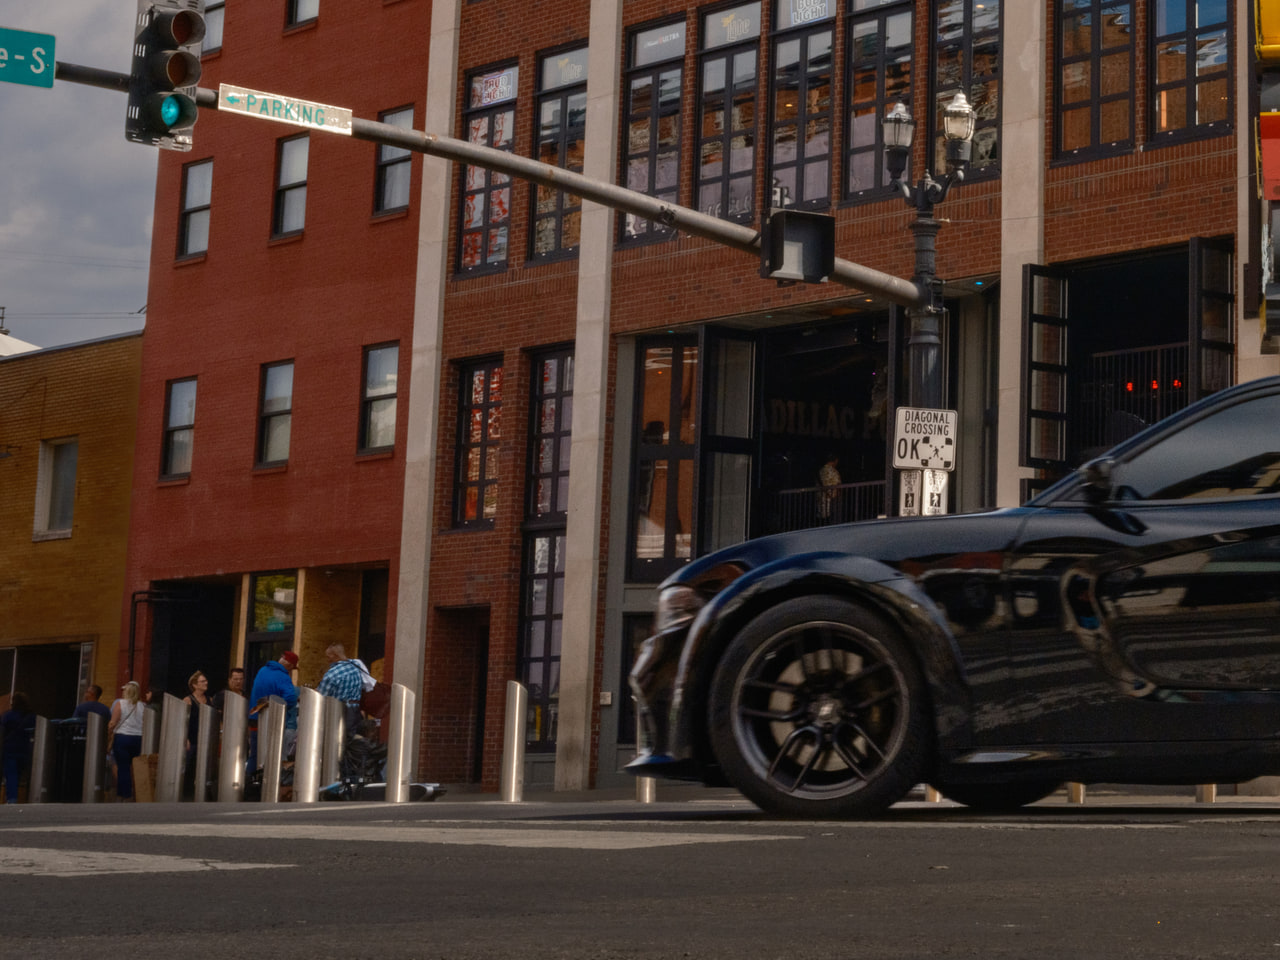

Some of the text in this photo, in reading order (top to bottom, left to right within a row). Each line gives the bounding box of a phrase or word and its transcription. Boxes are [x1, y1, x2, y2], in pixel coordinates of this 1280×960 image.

[792, 2, 826, 26] LIGHT
[246, 94, 326, 126] PARKING
[904, 410, 950, 424] DIAGONAL
[904, 422, 950, 436] CROSSING
[897, 437, 921, 460] OK
